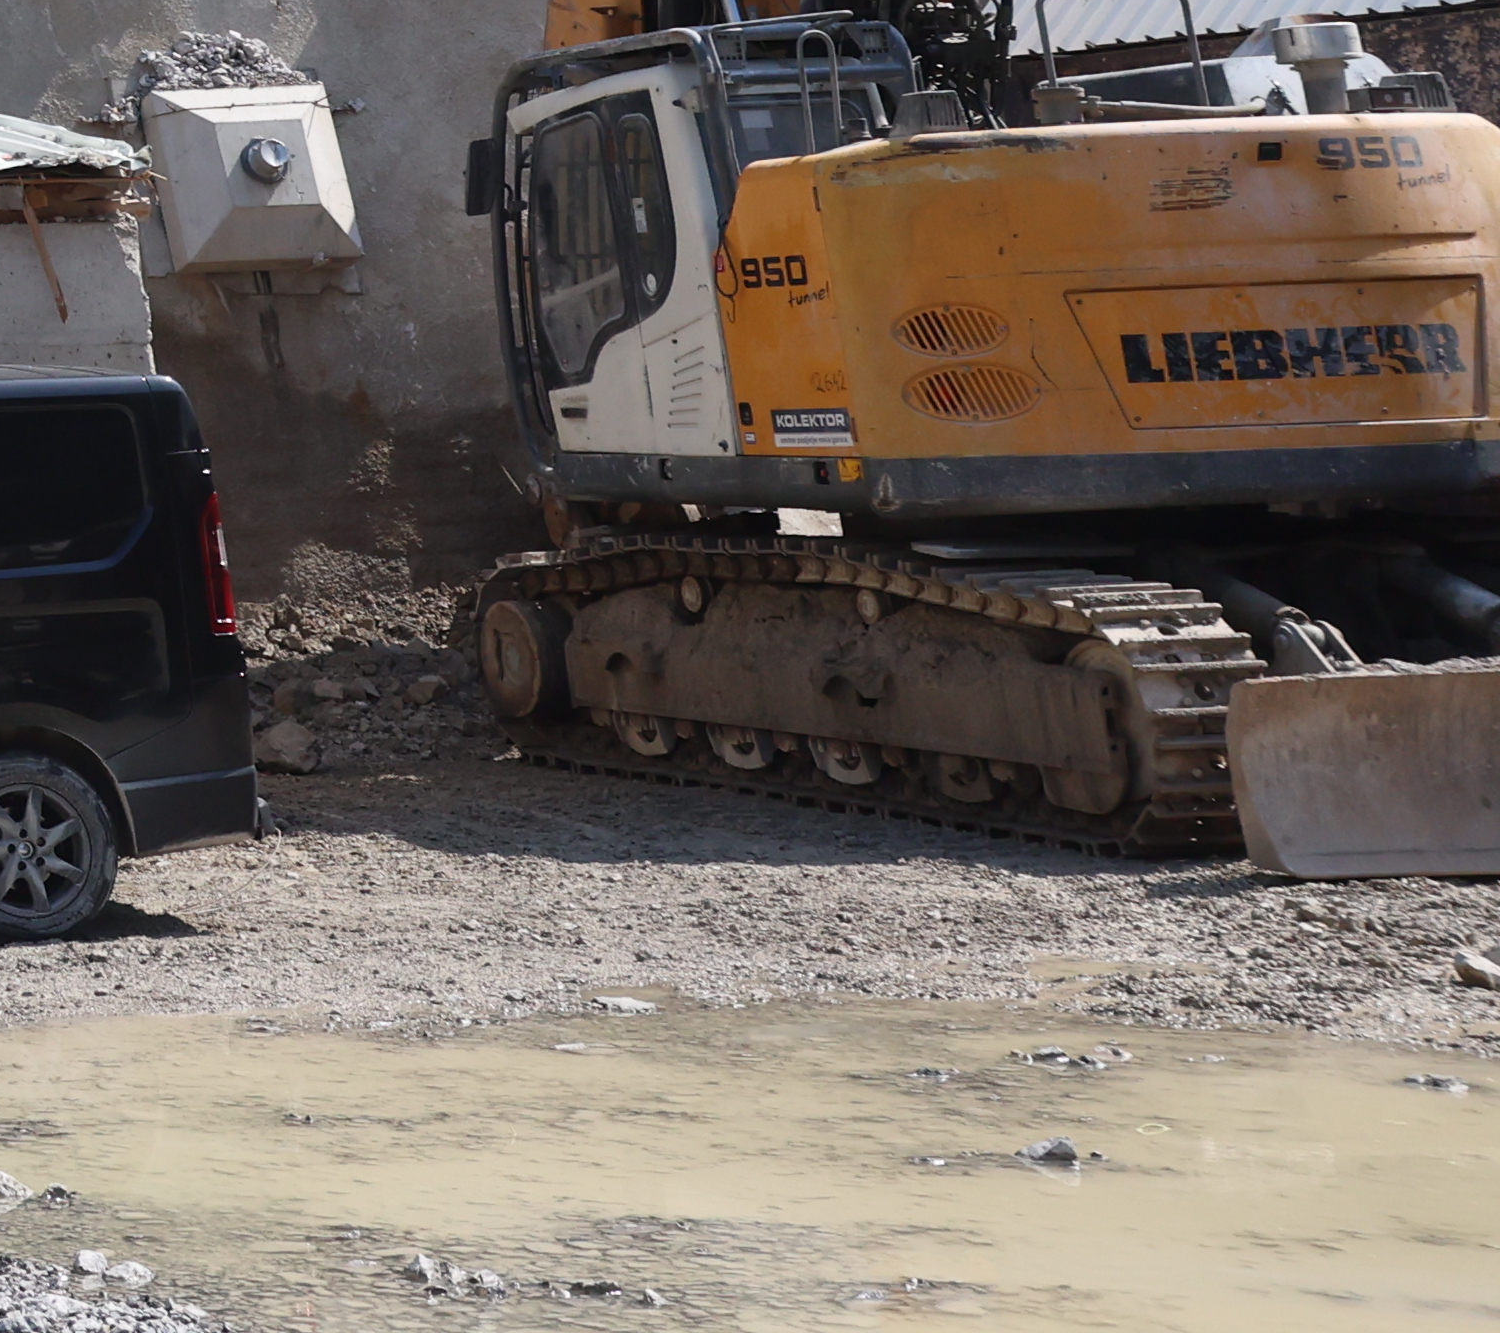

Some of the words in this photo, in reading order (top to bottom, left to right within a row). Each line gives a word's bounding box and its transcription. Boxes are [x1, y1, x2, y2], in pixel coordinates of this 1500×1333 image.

[1317, 135, 1423, 171] 950
[1396, 162, 1451, 192] tunnel
[741, 254, 808, 289] 950
[788, 280, 830, 309] tunnel
[1120, 322, 1467, 383] LIEBHERR
[775, 413, 846, 428] KOLEKTOR
